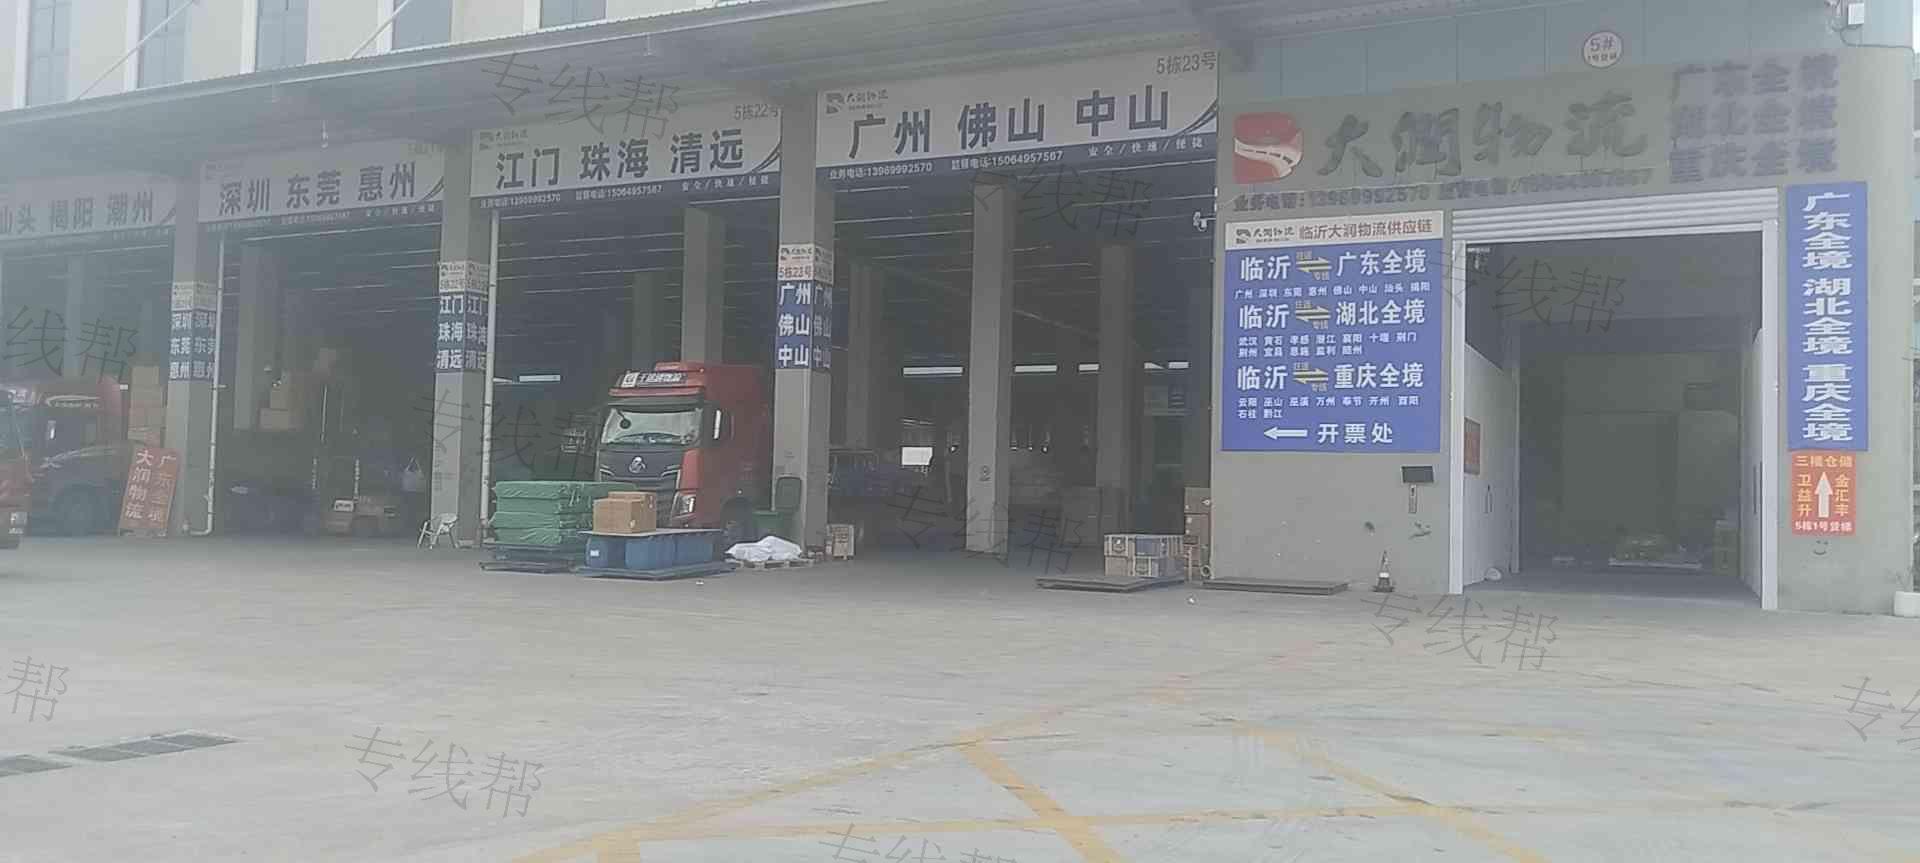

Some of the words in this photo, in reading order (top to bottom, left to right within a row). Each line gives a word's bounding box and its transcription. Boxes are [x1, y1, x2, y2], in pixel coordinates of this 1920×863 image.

[1591, 36, 1616, 51] 5#
[1157, 51, 1216, 74] 5栋23号
[1671, 54, 1838, 101] 广东全境
[849, 109, 930, 158] 广州
[958, 99, 1046, 149] 佛山
[1077, 84, 1168, 136] 中山
[1317, 89, 1648, 178] 大润物流
[496, 148, 561, 190] 江门
[579, 138, 650, 182] 珠海
[670, 128, 744, 174] 清远
[219, 178, 271, 216] 深圳
[287, 168, 342, 208] 东莞
[358, 161, 417, 201] 惠州
[49, 197, 95, 232] 揭阳
[104, 186, 153, 227] 潮州
[1299, 219, 1432, 240] 临沂大润物流供应链
[1802, 191, 1852, 269] 广东全境
[1240, 255, 1291, 281] 临沂
[1337, 248, 1427, 276] 广东全境
[780, 282, 811, 305] 广州
[1235, 290, 1252, 299] 广州
[1358, 284, 1378, 294] 中山
[440, 295, 464, 314] 江门
[1239, 303, 1290, 329] 临沂
[1336, 298, 1426, 325] 湖北全境
[172, 312, 192, 329] 深圳
[779, 313, 810, 336] 佛山
[1802, 278, 1852, 355] 湖北全境
[438, 322, 463, 342] 珠海
[171, 337, 191, 354] 东莞
[779, 344, 809, 367] 中山
[170, 361, 191, 379] 惠州
[436, 349, 463, 369] 清远
[1237, 365, 1288, 391] 临沂
[1334, 362, 1424, 389] 重庆全境
[1316, 396, 1336, 406] 万州
[1801, 363, 1853, 441] 重庆全境
[1318, 422, 1393, 444] 开票处
[125, 449, 154, 519] 大润物流
